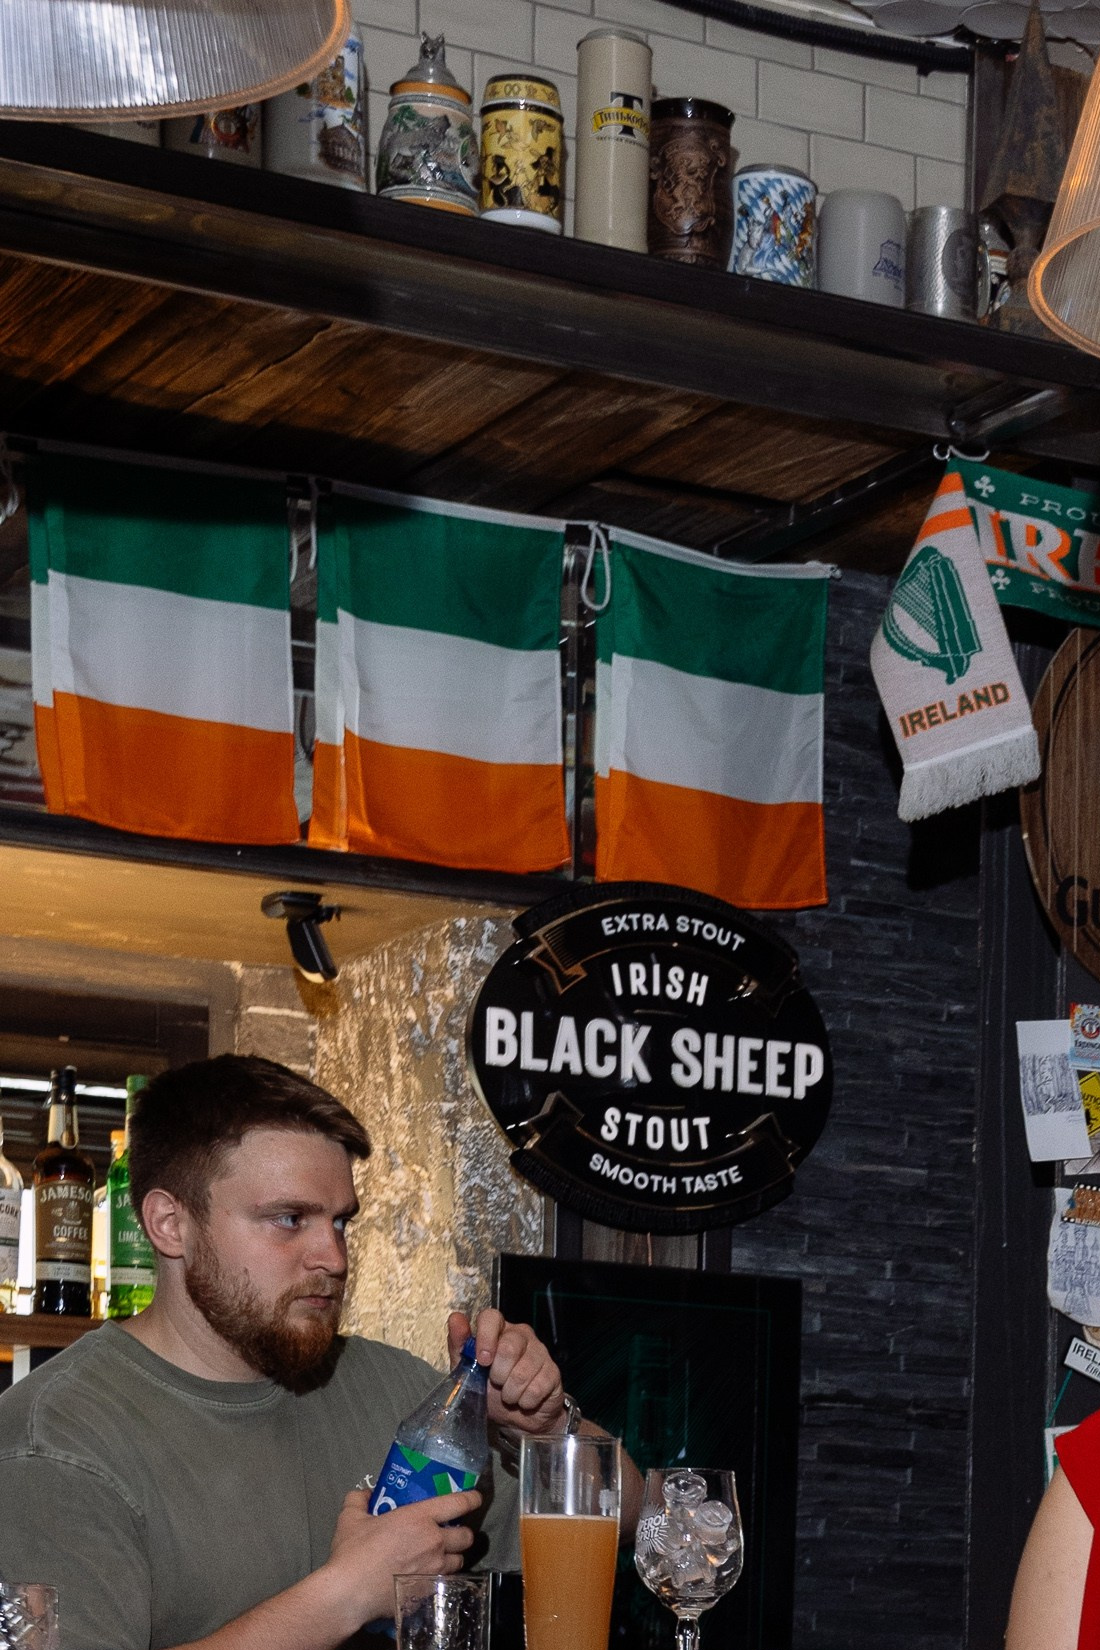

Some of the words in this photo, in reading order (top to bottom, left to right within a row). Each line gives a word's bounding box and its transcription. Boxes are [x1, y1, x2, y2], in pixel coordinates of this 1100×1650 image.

[898, 681, 1011, 739] IRELAND
[601, 913, 669, 936] EXTRA
[676, 915, 746, 951] STOUT
[611, 962, 709, 1007] IRISH
[485, 1006, 652, 1084] BLACK
[671, 1027, 825, 1101] SHEEP
[600, 1106, 711, 1151] STOUT
[590, 1153, 677, 1195] SMOOTH
[682, 1165, 743, 1195] TASTE
[53, 1225, 88, 1241] COFFEE
[639, 1513, 668, 1531] PEROL
